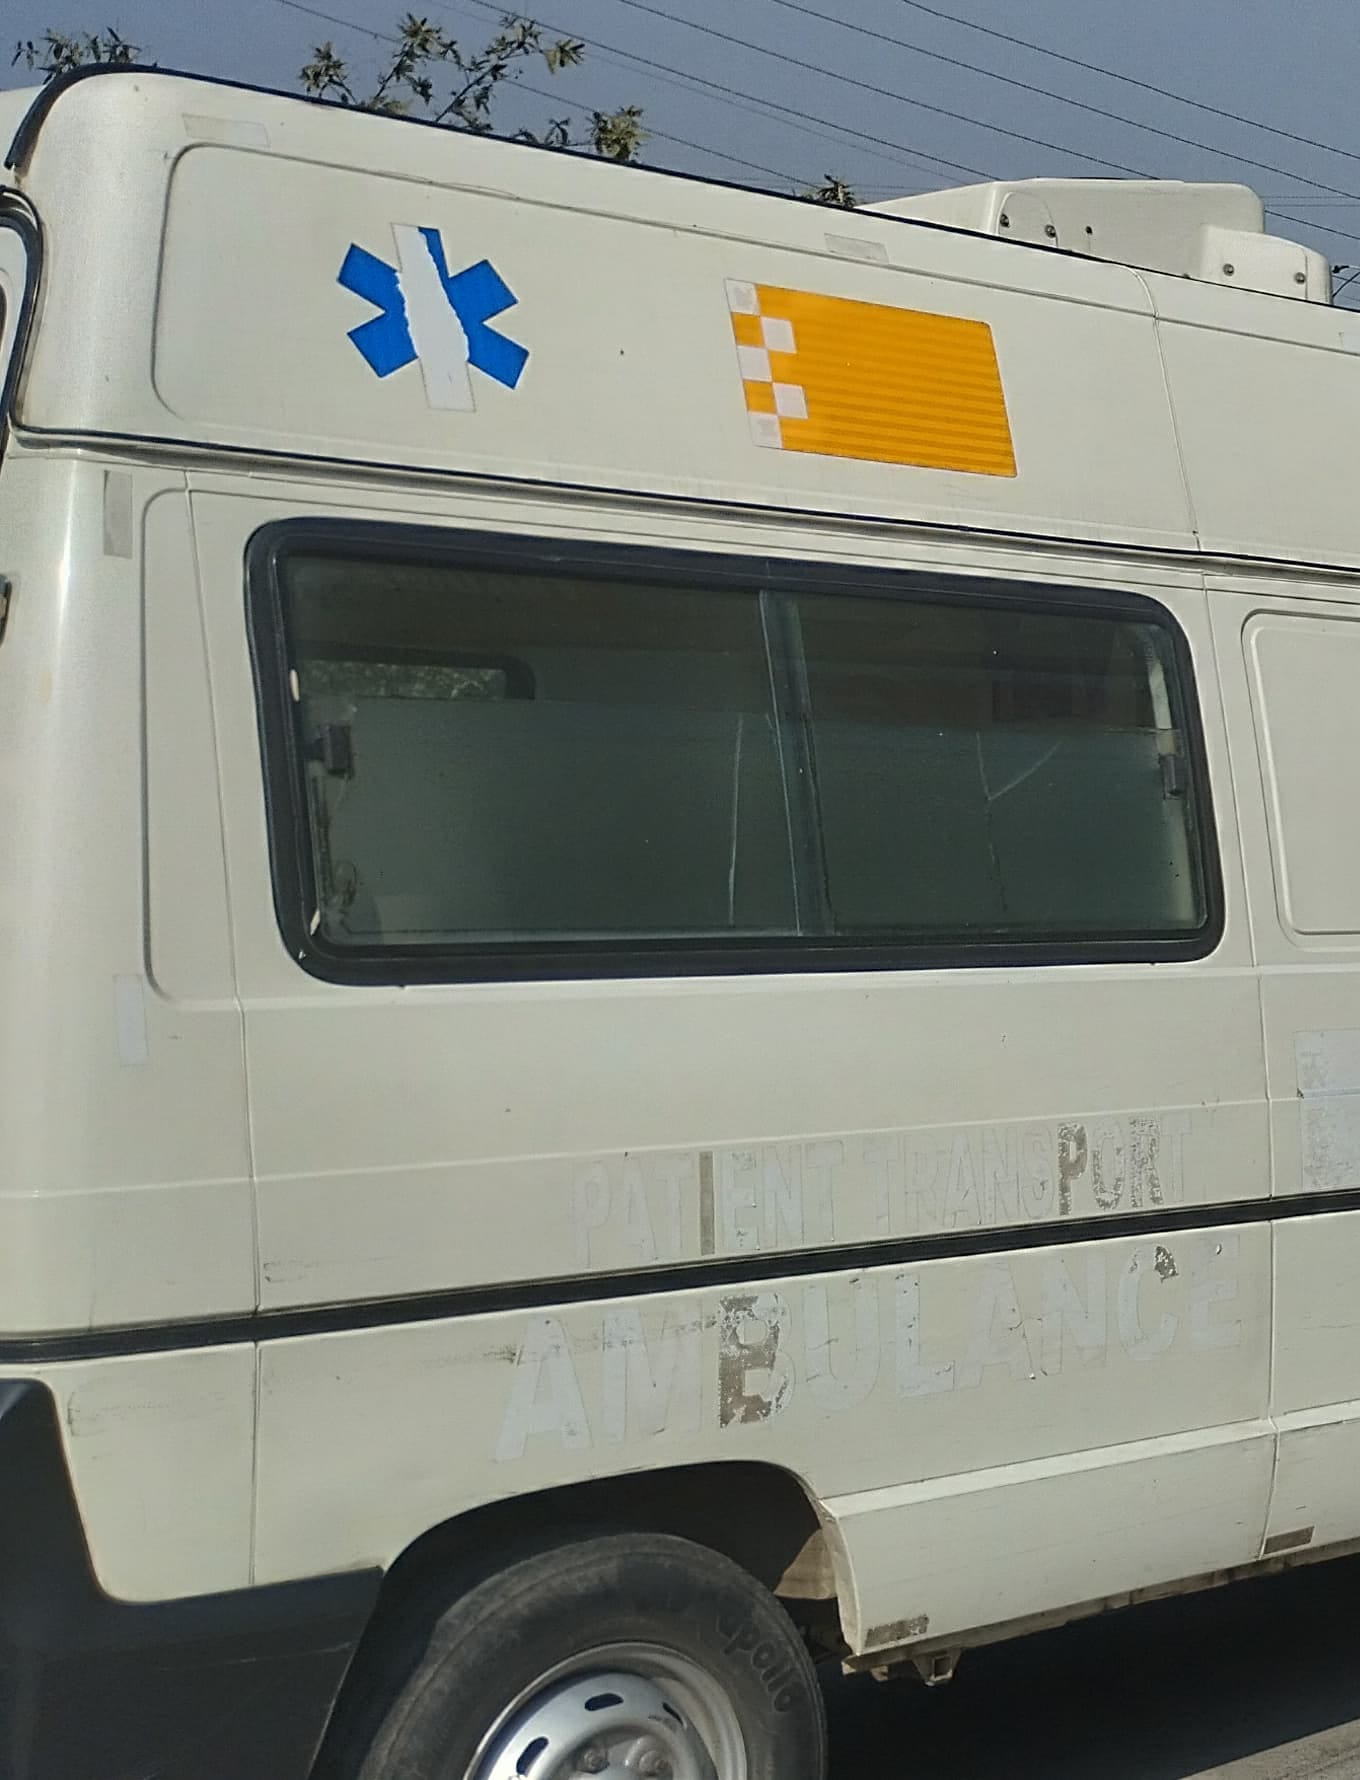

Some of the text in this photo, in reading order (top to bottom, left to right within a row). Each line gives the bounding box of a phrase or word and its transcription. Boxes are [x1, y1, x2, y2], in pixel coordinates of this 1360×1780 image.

[575, 1114, 1192, 1269] PATIENT TRANSPORT
[493, 1234, 1246, 1463] AMBULANCE
